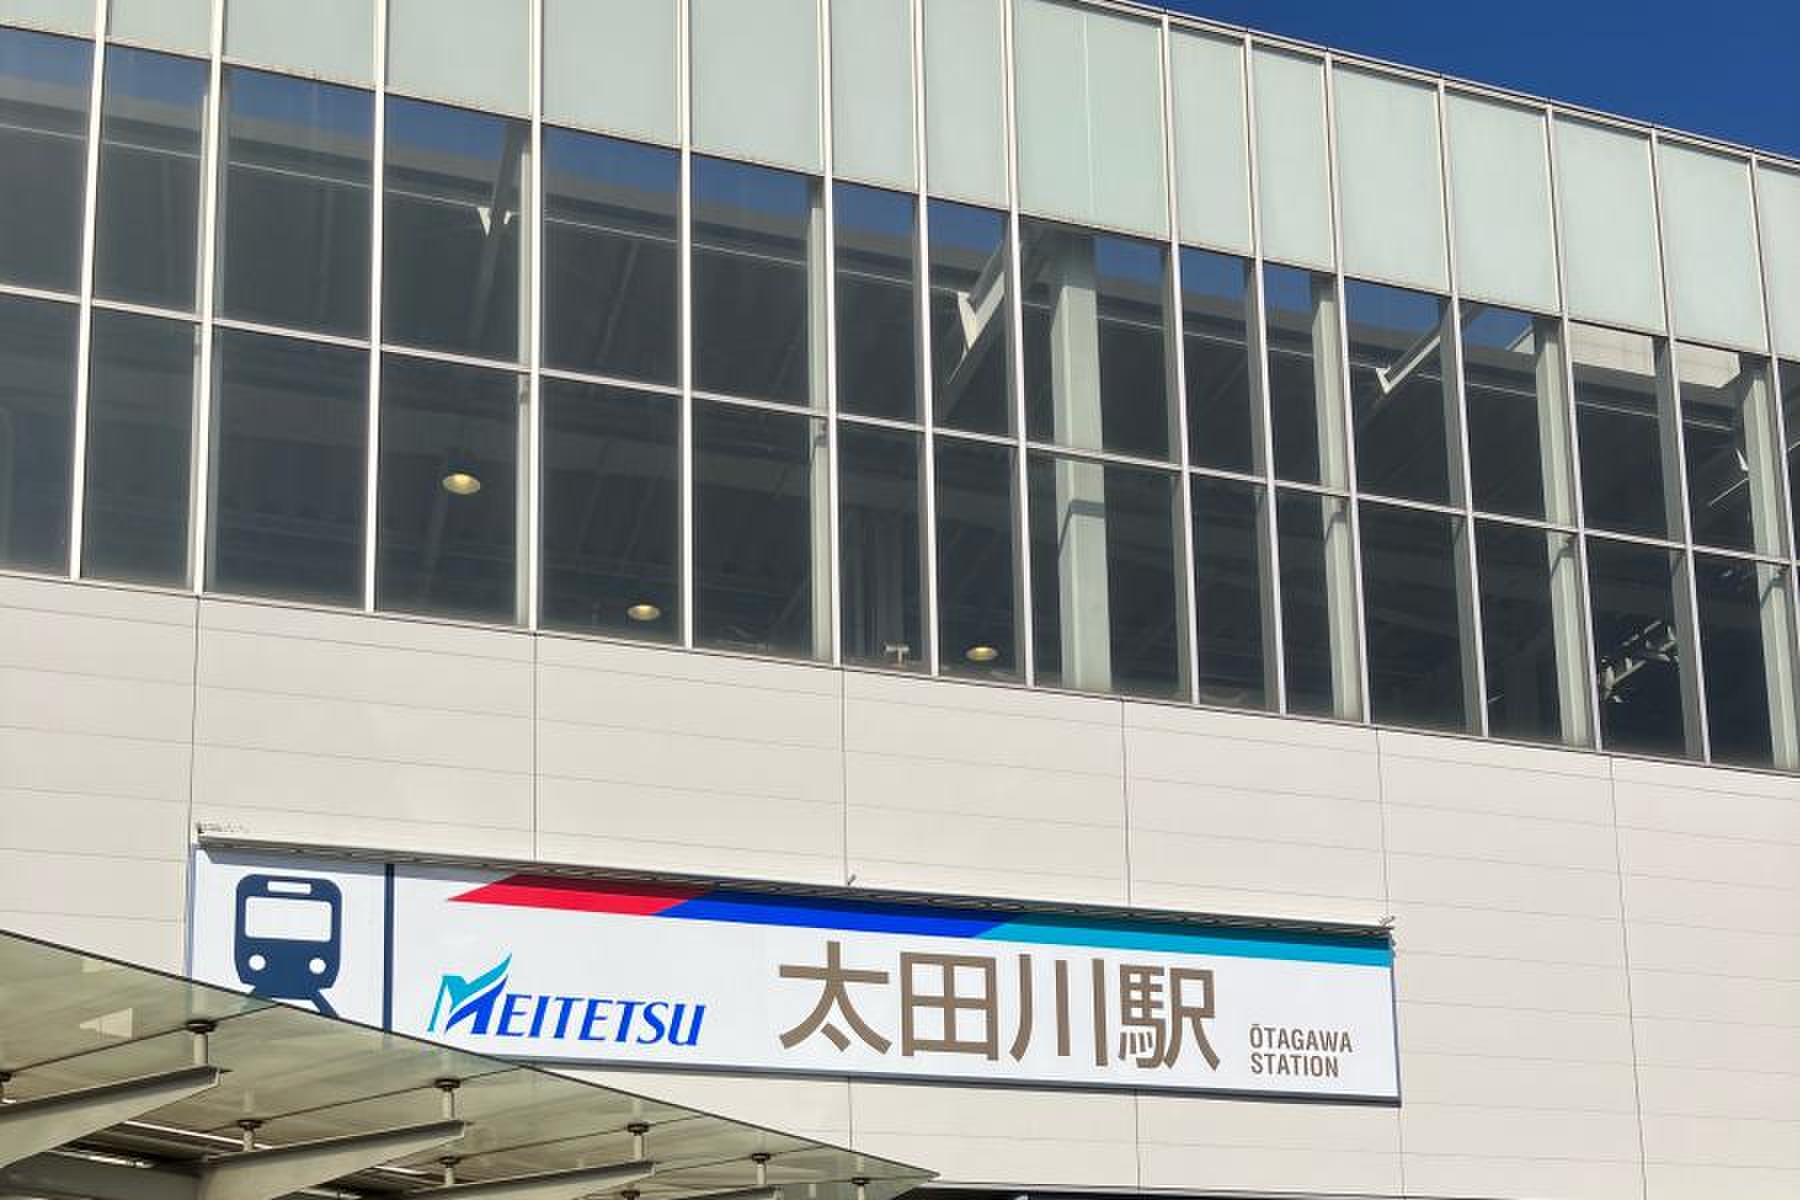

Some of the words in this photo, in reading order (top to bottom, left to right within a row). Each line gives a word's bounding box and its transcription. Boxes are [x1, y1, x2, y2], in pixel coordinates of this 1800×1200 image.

[427, 951, 706, 1047] MEITETSU
[777, 940, 1221, 1070] 太田川駅
[1249, 1023, 1354, 1054] ŌTAGAWA
[1249, 1052, 1340, 1078] STATION
